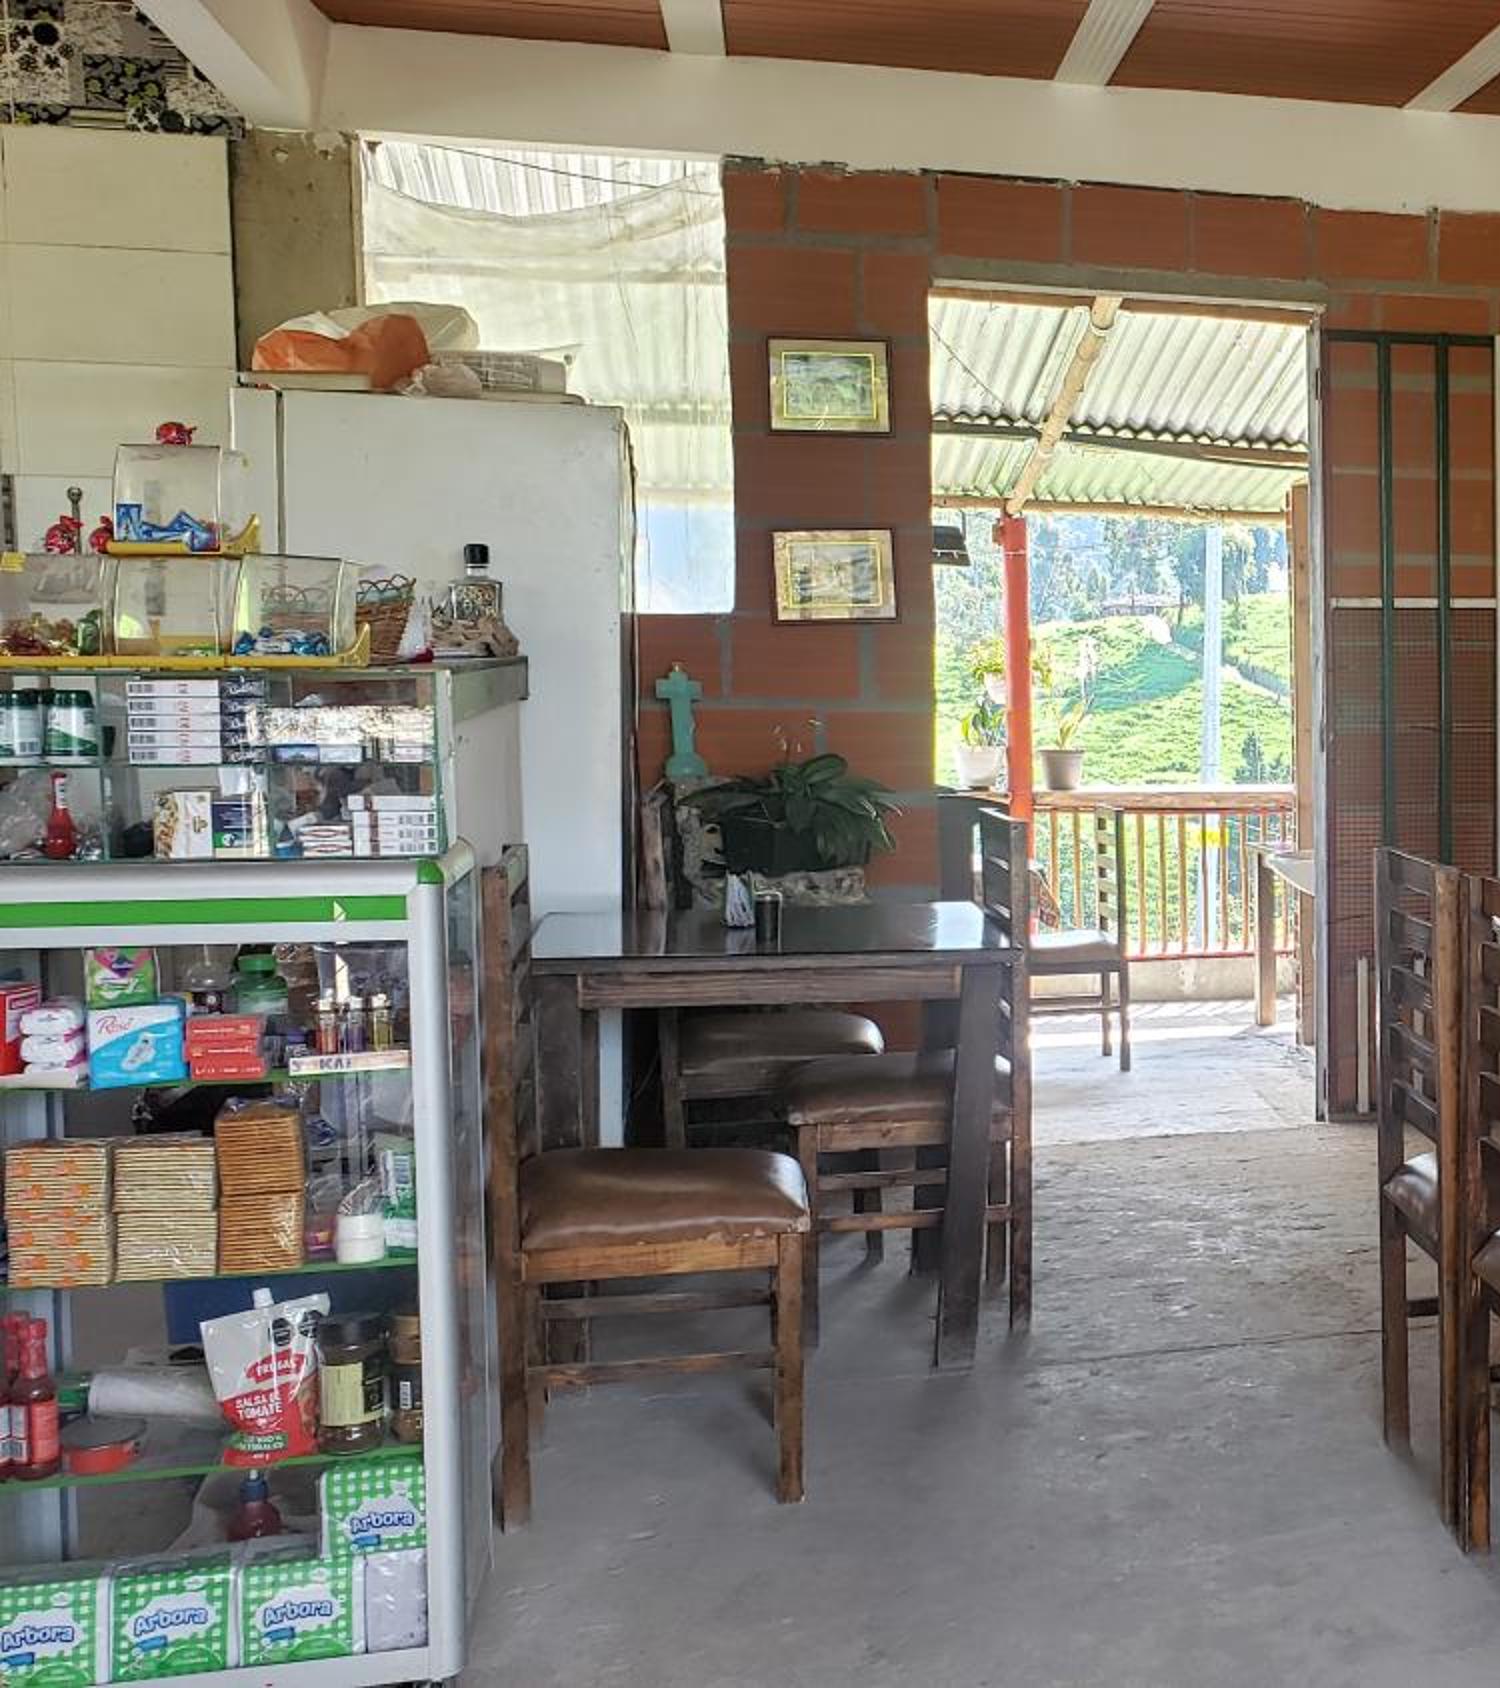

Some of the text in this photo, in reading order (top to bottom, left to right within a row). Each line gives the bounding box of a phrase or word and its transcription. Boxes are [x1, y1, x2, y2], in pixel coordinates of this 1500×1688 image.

[351, 1512, 414, 1534] Arbora
[134, 1607, 208, 1636] Arbora
[264, 1600, 333, 1626] Arbora
[2, 1625, 75, 1652] Arbora
